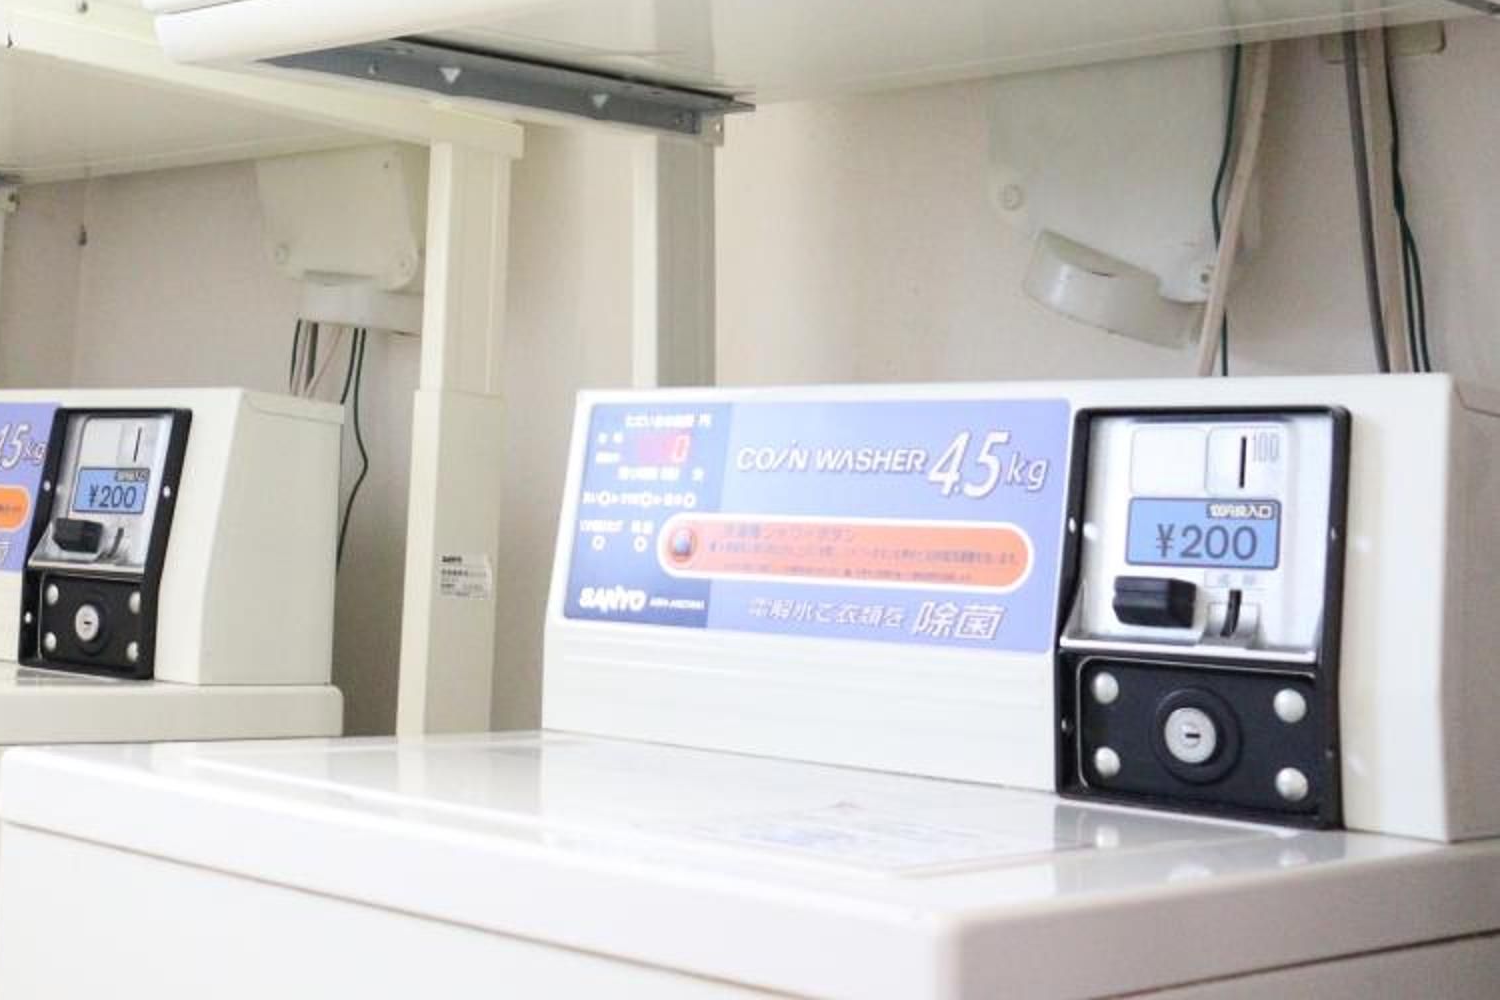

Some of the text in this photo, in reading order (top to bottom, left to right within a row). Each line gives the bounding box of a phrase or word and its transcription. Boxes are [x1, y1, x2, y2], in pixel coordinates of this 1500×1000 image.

[815, 449, 927, 474] WASHER
[1252, 431, 1280, 463] 100
[87, 482, 138, 509] ¥200
[1155, 522, 1258, 561] ¥200
[579, 585, 647, 613] SANYO
[911, 600, 1005, 641] 除菌
